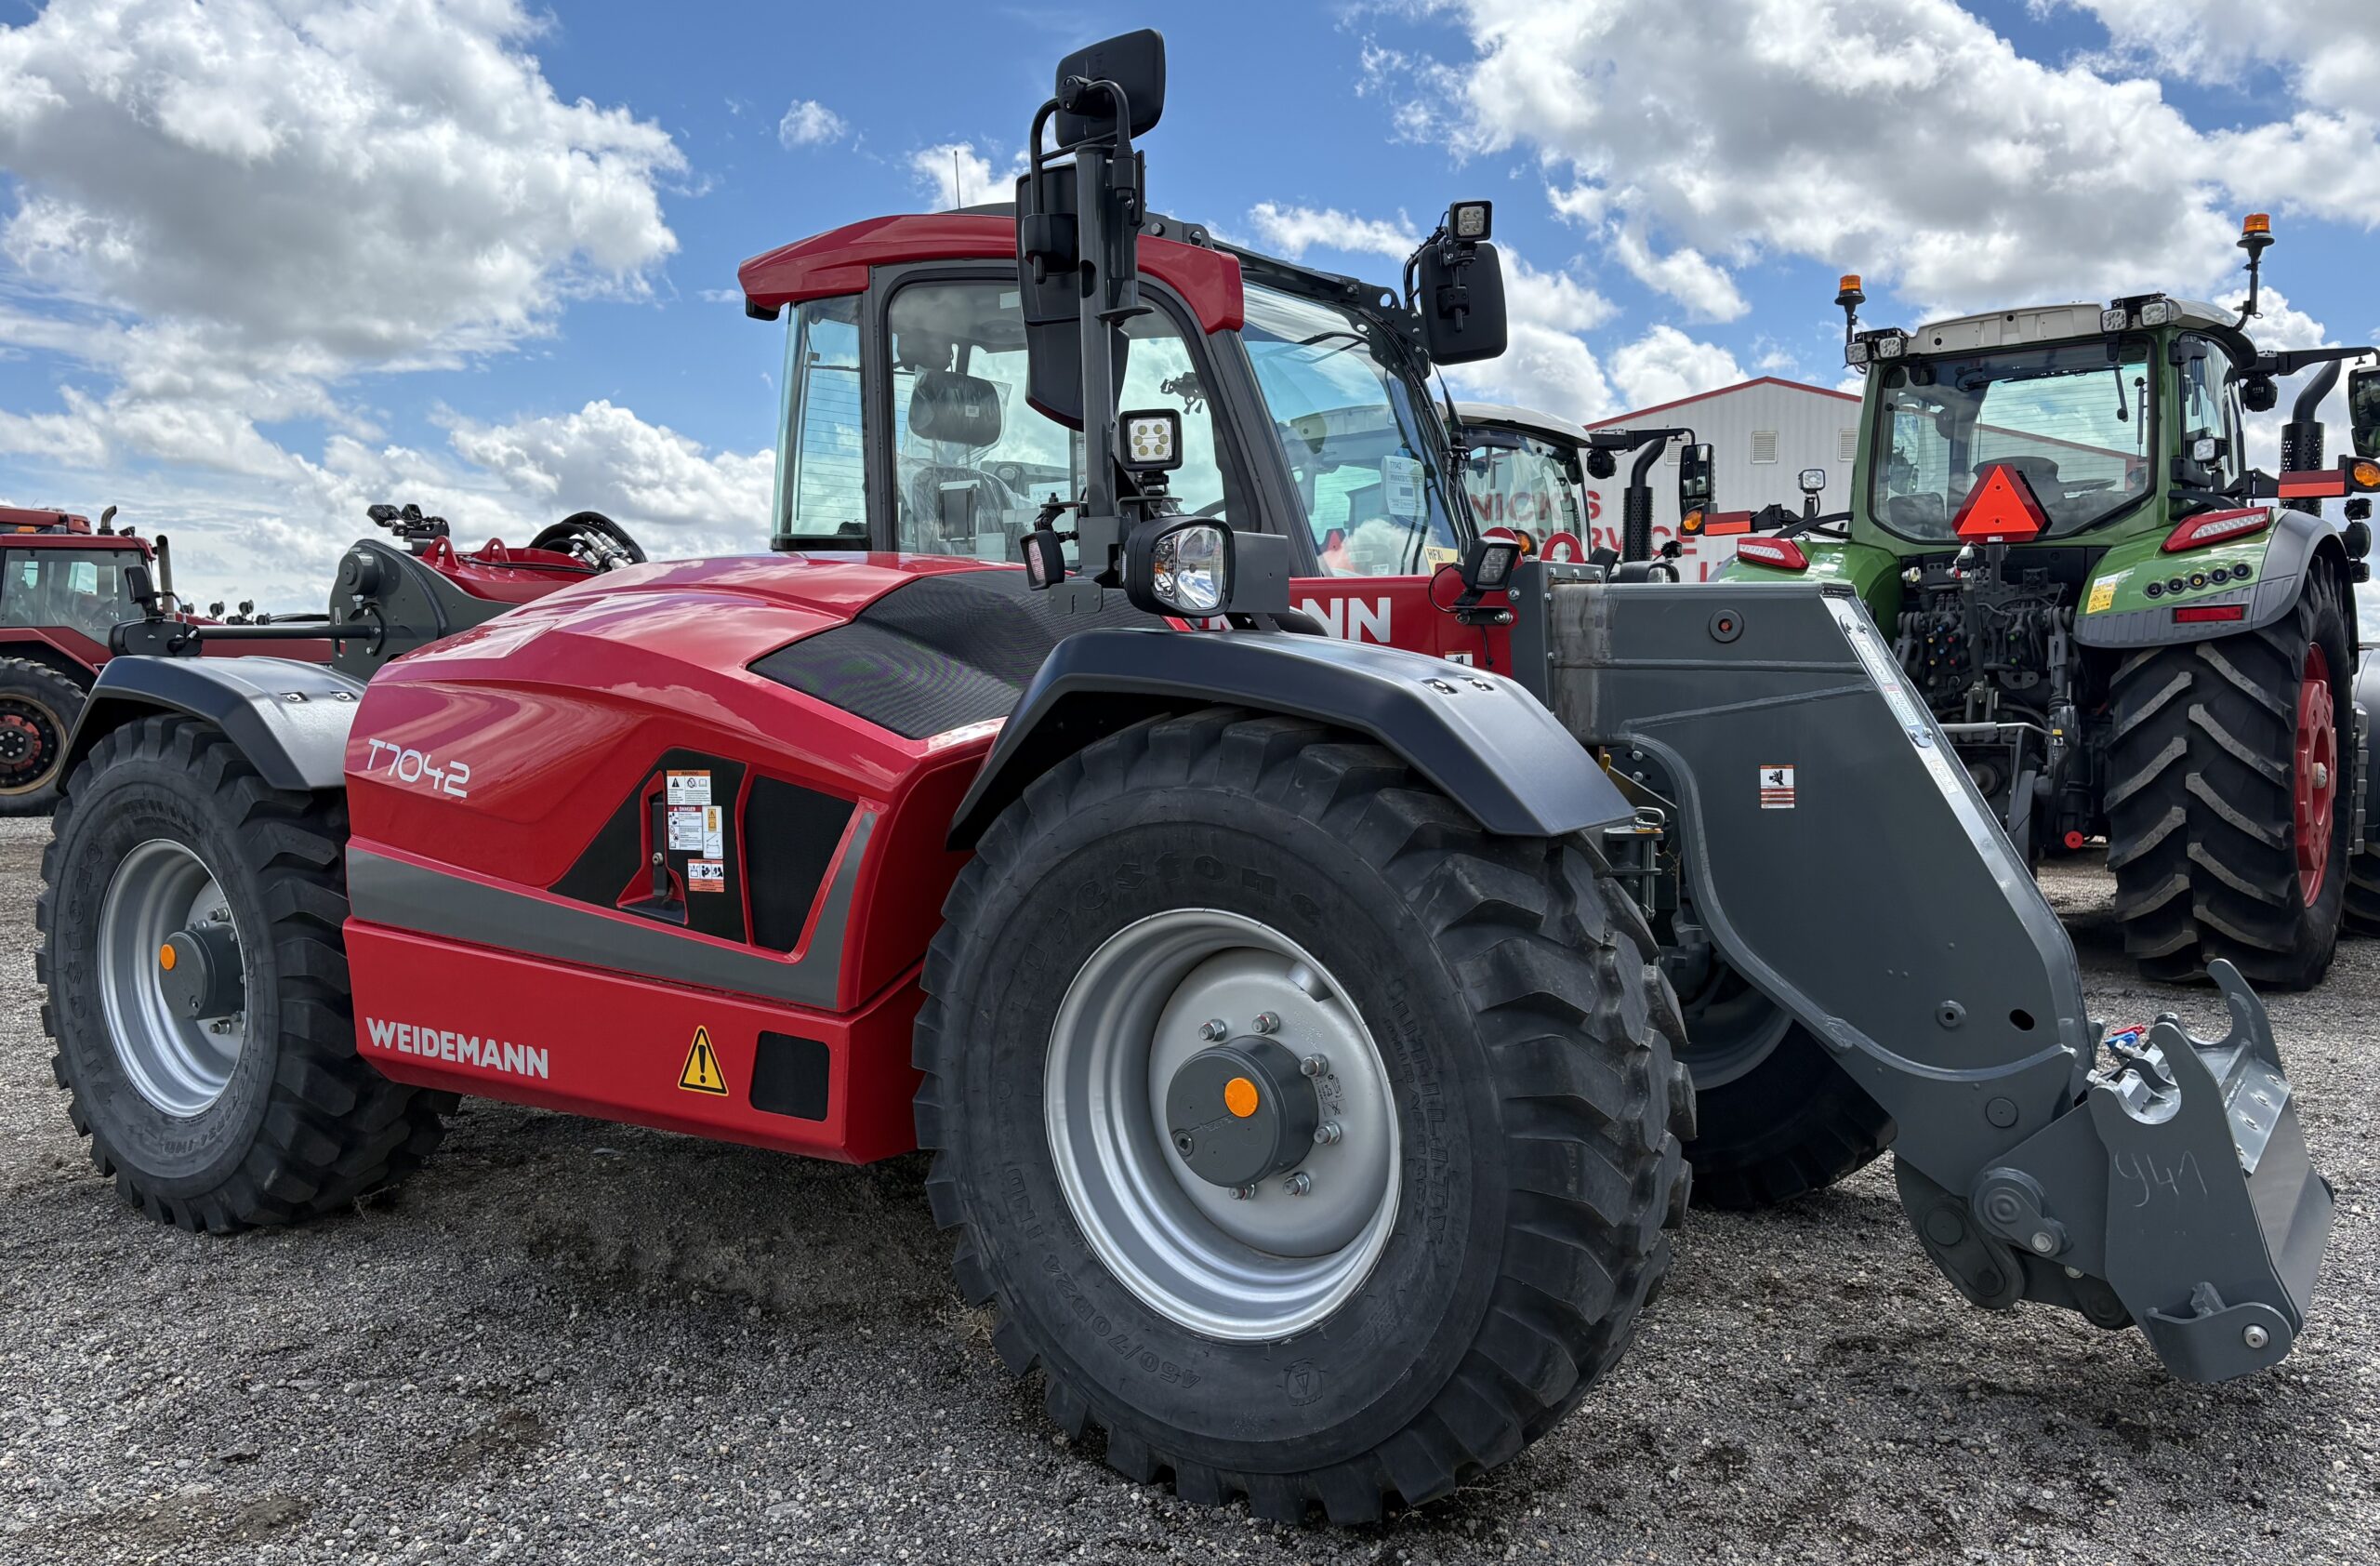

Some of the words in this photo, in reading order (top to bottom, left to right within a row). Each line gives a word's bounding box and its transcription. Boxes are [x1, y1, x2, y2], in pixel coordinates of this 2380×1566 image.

[367, 738, 470, 798] T7042
[365, 1016, 549, 1080] WEIDEMANN
[1007, 1167, 1043, 1241] IND
[1041, 1254, 1201, 1389] 450/70R24
